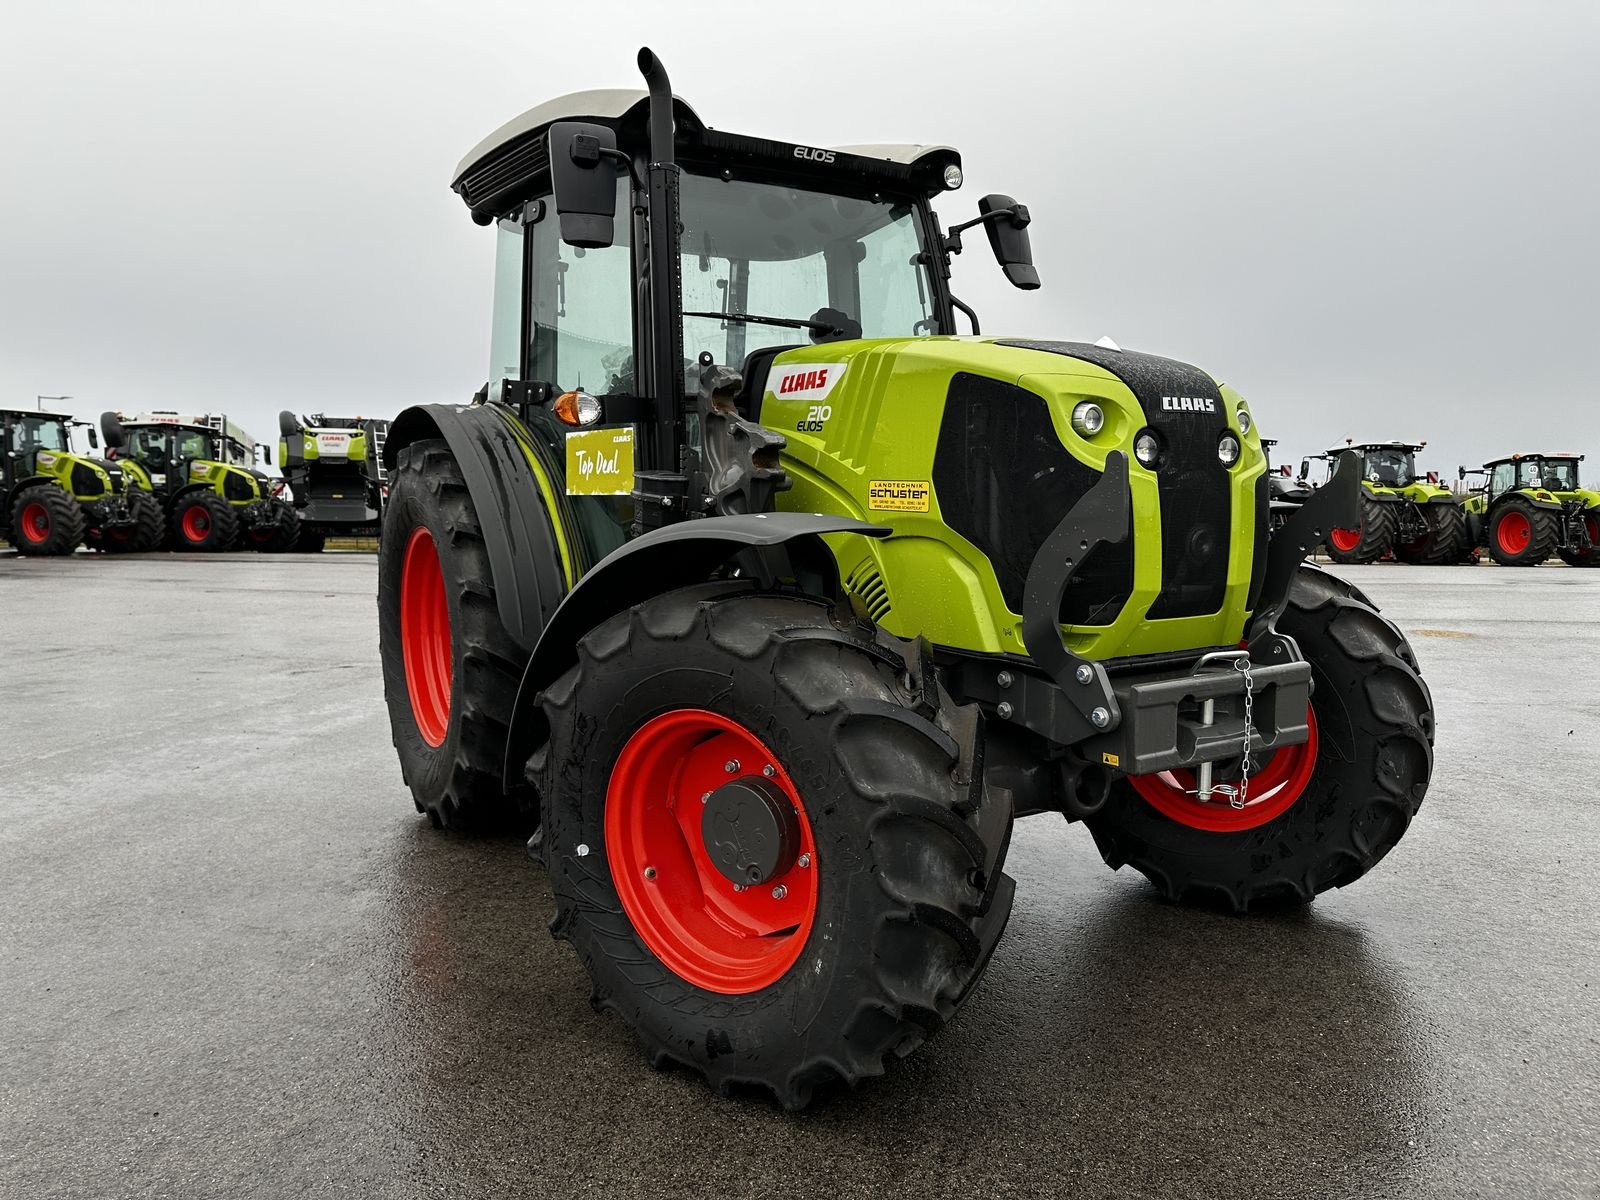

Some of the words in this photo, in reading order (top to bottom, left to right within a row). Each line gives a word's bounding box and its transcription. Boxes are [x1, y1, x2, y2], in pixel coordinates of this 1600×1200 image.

[794, 147, 836, 163] ELIOS
[780, 369, 828, 394] CLAAS
[1162, 397, 1215, 412] CLAAS
[807, 405, 832, 421] 210
[797, 421, 823, 432] ELIOS
[613, 435, 631, 443] CLAAS
[576, 450, 594, 481] Top
[596, 449, 620, 475] Deal
[870, 488, 928, 500] schuster
